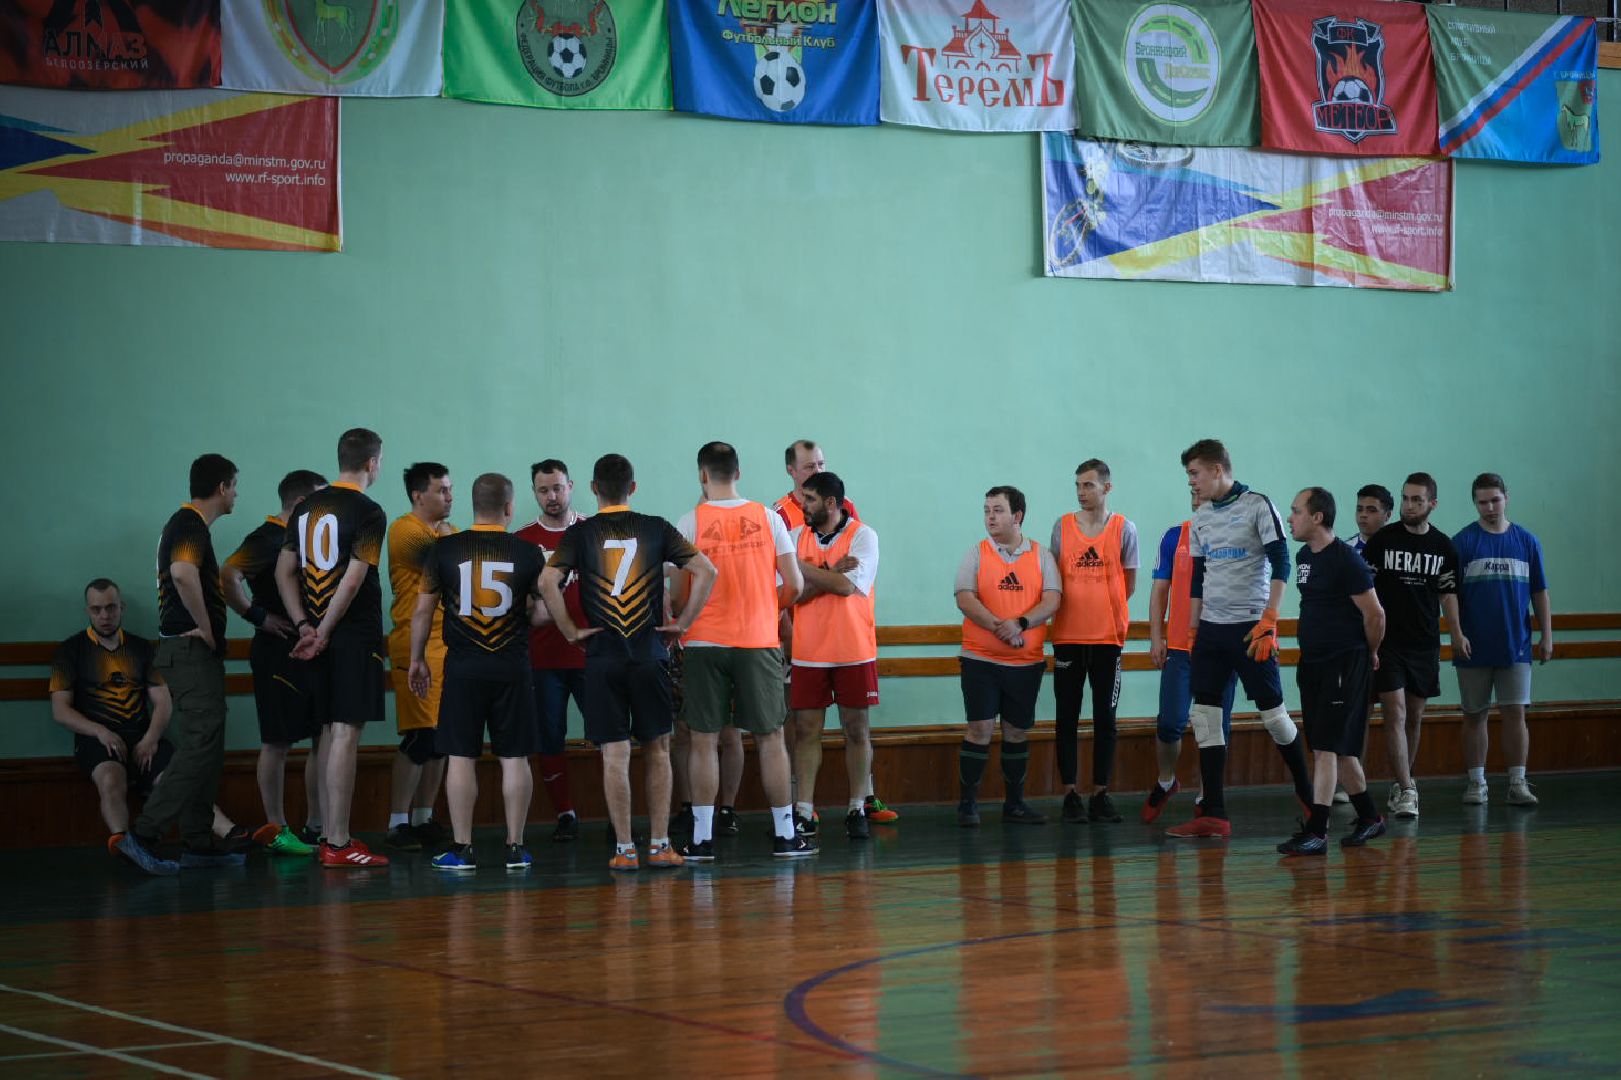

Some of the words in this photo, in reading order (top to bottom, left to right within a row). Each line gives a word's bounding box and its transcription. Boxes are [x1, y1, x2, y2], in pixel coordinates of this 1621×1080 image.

[43, 31, 146, 60] АЛМАЗ
[722, 29, 800, 46] Футбольный
[803, 36, 835, 48] Клуб
[1316, 103, 1391, 130] МЕТЕОР
[163, 151, 326, 171] propaganda@minstm.gov.ru
[225, 171, 326, 186] www.rf-sport.info
[298, 511, 339, 571] 10
[603, 537, 638, 596] 7
[1484, 561, 1510, 573] Kappa
[458, 560, 515, 617] 15
